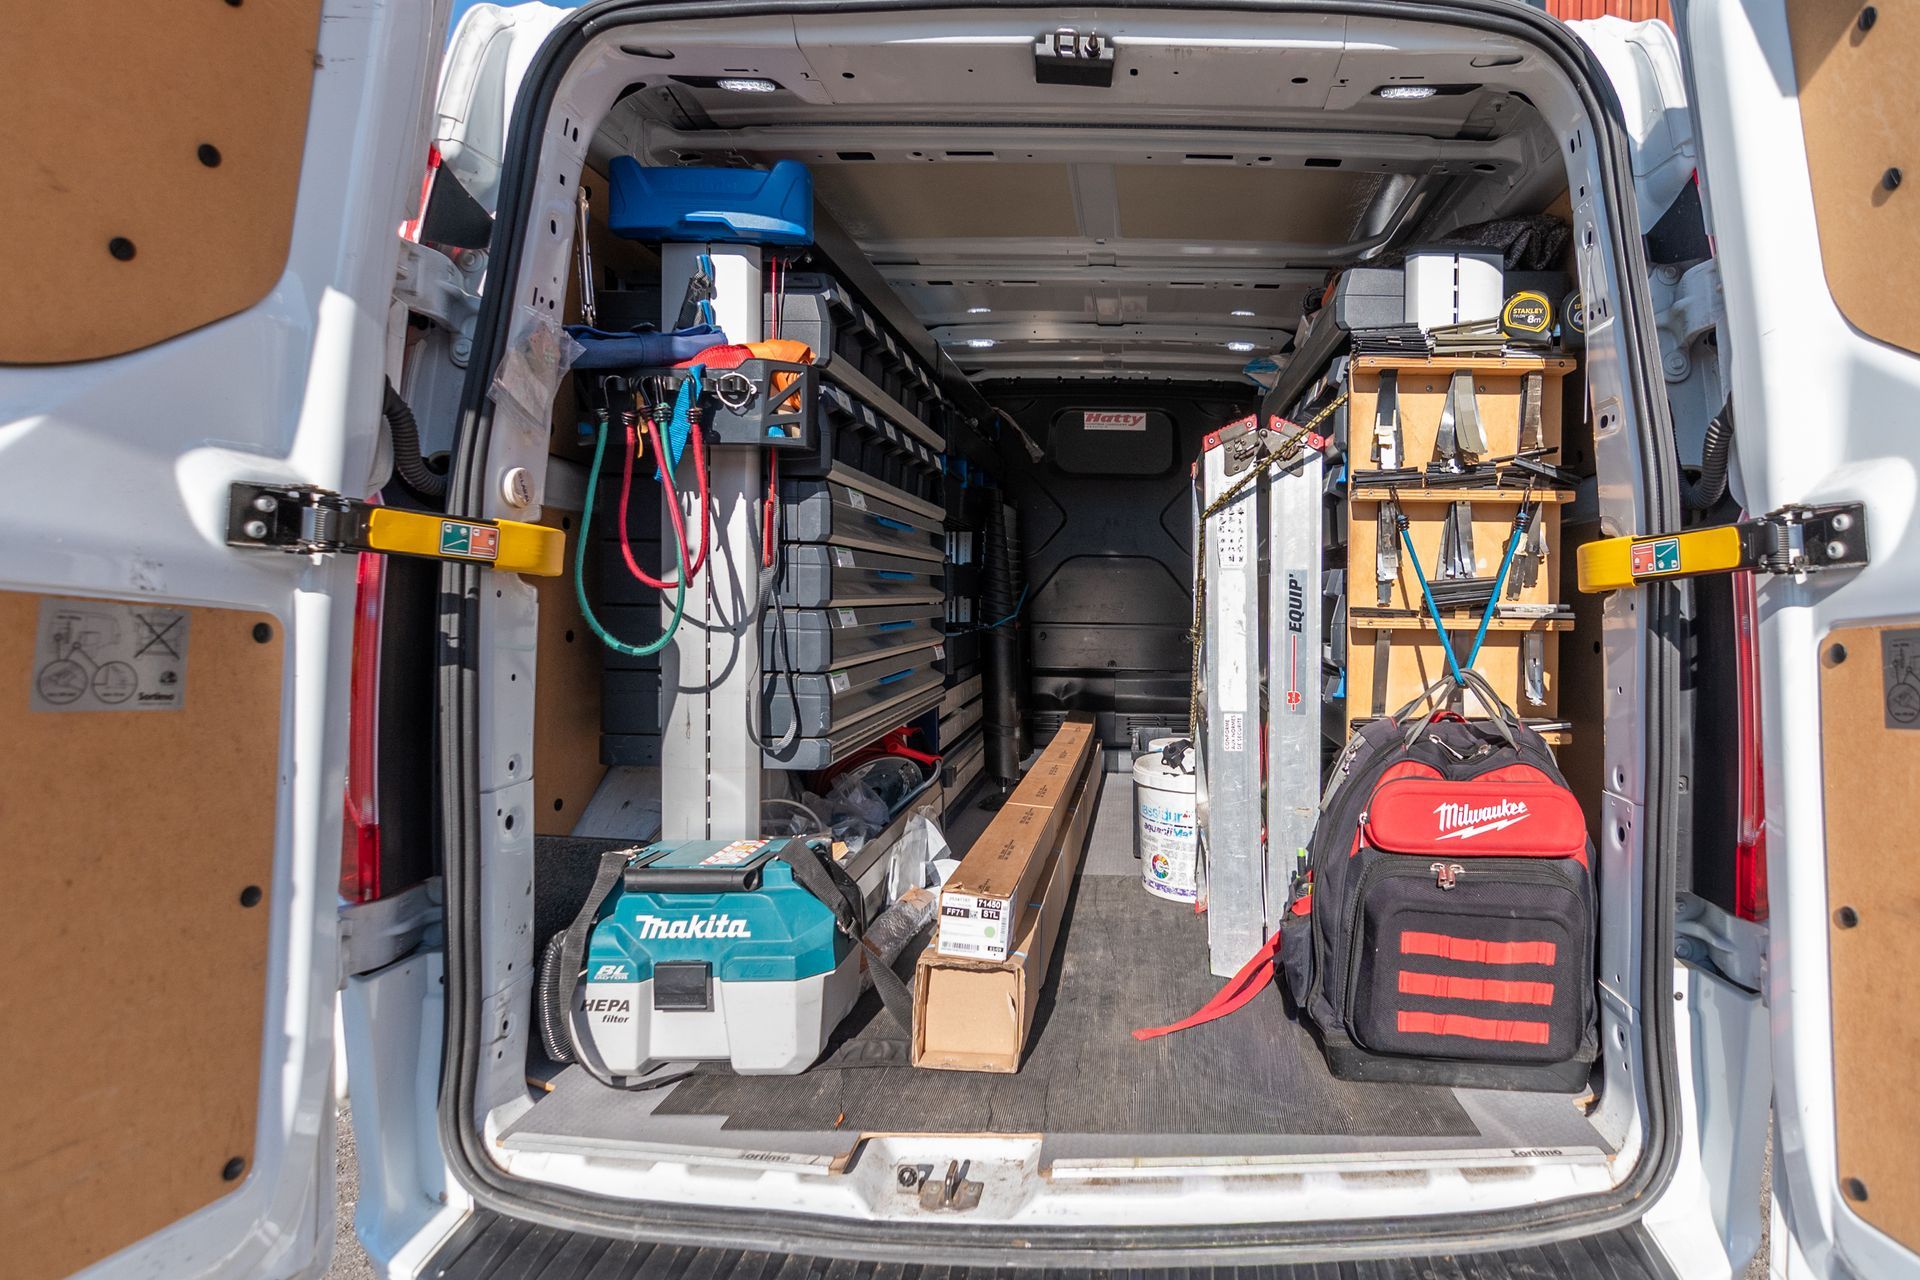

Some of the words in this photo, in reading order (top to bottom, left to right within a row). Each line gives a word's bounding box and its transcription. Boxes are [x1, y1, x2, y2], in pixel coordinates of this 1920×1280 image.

[1527, 315, 1542, 324] 8m
[1085, 413, 1145, 427] Hatty
[1433, 798, 1528, 832] Milwaukee
[978, 899, 1001, 909] 71450
[946, 907, 964, 916] FF71
[983, 910, 999, 919] STL
[635, 914, 752, 939] Makita
[580, 999, 630, 1012] HEPA
[602, 1014, 630, 1024] filter
[1511, 1149, 1562, 1158] Sortimo
